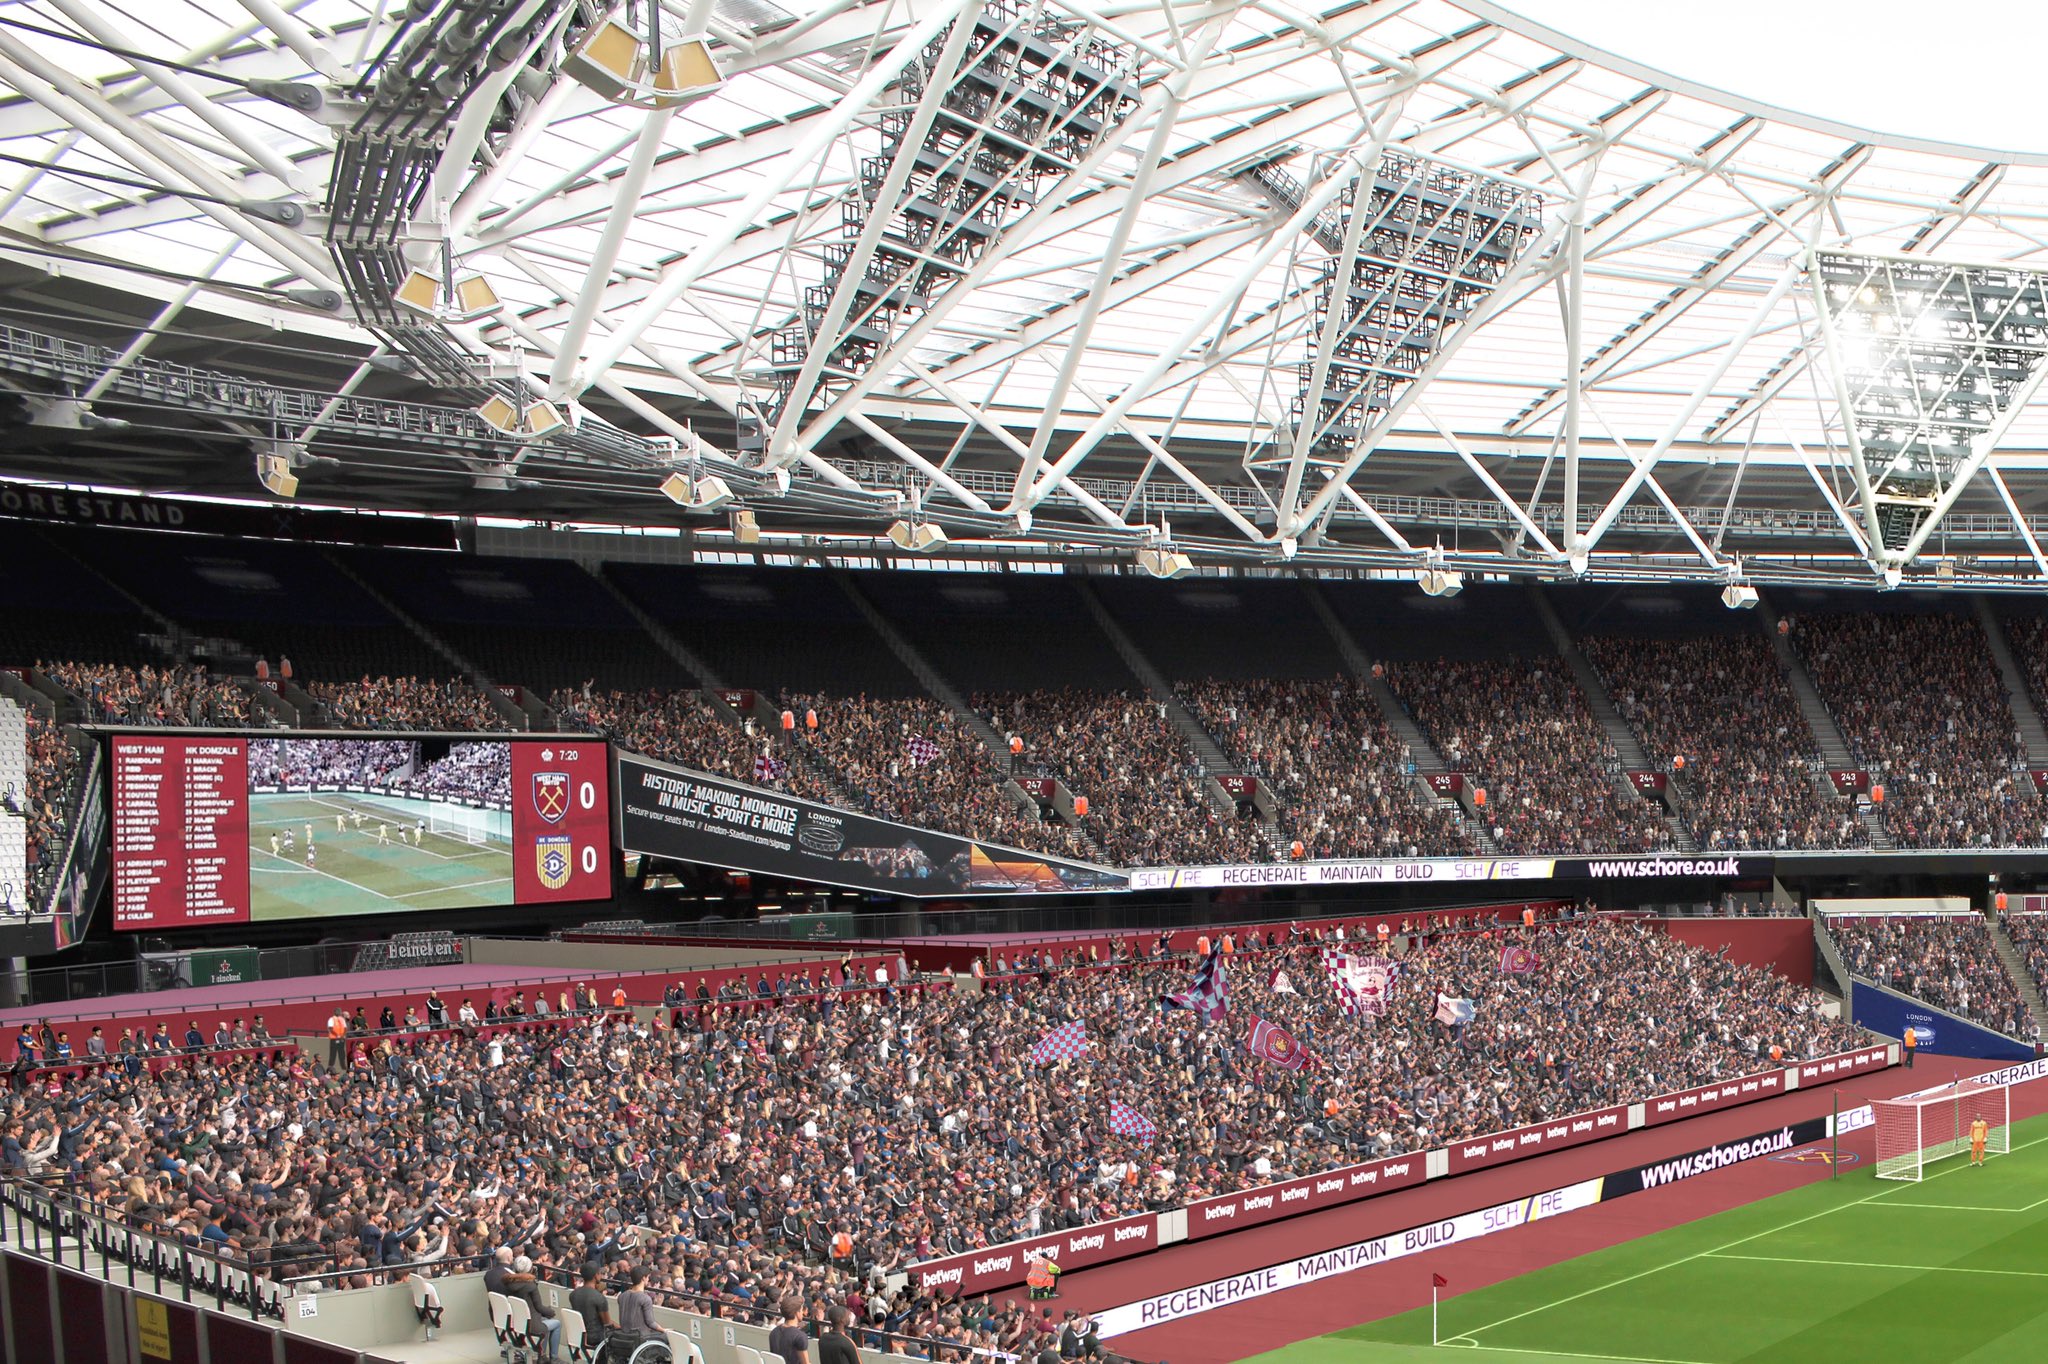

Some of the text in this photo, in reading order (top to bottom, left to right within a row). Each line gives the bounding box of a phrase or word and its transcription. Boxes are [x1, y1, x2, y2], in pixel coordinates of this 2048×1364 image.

[77, 497, 184, 525] STAND
[726, 692, 742, 701] 248
[118, 745, 164, 754] WEST HAM
[199, 747, 238, 755] DOMZALE
[560, 750, 578, 760] 7:20
[1026, 781, 1042, 789] 247
[1228, 778, 1244, 787] 246
[1436, 776, 1450, 784] 245
[580, 782, 595, 809] 0
[642, 773, 798, 822] HISTORY-MAKING MOMENTS
[658, 792, 795, 836] IN MUSIC, SPORT & MORE
[808, 812, 842, 826] LONDON
[627, 805, 791, 851] Secure your seats first London-Stadium.com/signup
[582, 846, 597, 874] 0
[1223, 864, 1433, 884] REGENERATE MAINTAIN BUILD
[1588, 857, 1740, 878] www.schore.co.uk
[1906, 1014, 1933, 1022] LONDON
[1573, 1121, 1593, 1132] betway
[1598, 1115, 1617, 1126] betway
[1520, 1133, 1542, 1144] betway
[1547, 1127, 1567, 1138] betway
[1464, 1146, 1487, 1158] betway
[1493, 1139, 1514, 1151] betway
[1641, 1127, 1793, 1189] www.schore.co.uk
[1384, 1164, 1409, 1177] betway
[1351, 1171, 1377, 1185] betway
[1317, 1179, 1344, 1193] betway
[1282, 1187, 1309, 1201] betway
[1245, 1195, 1273, 1210] betway
[1206, 1204, 1236, 1219] betway
[1115, 1224, 1148, 1241] betway
[1070, 1234, 1105, 1252] betway
[974, 1256, 1012, 1275] betway
[1142, 1222, 1455, 1323] REGENERATE MAINTAIN BUILD
[922, 1268, 963, 1287] betway
